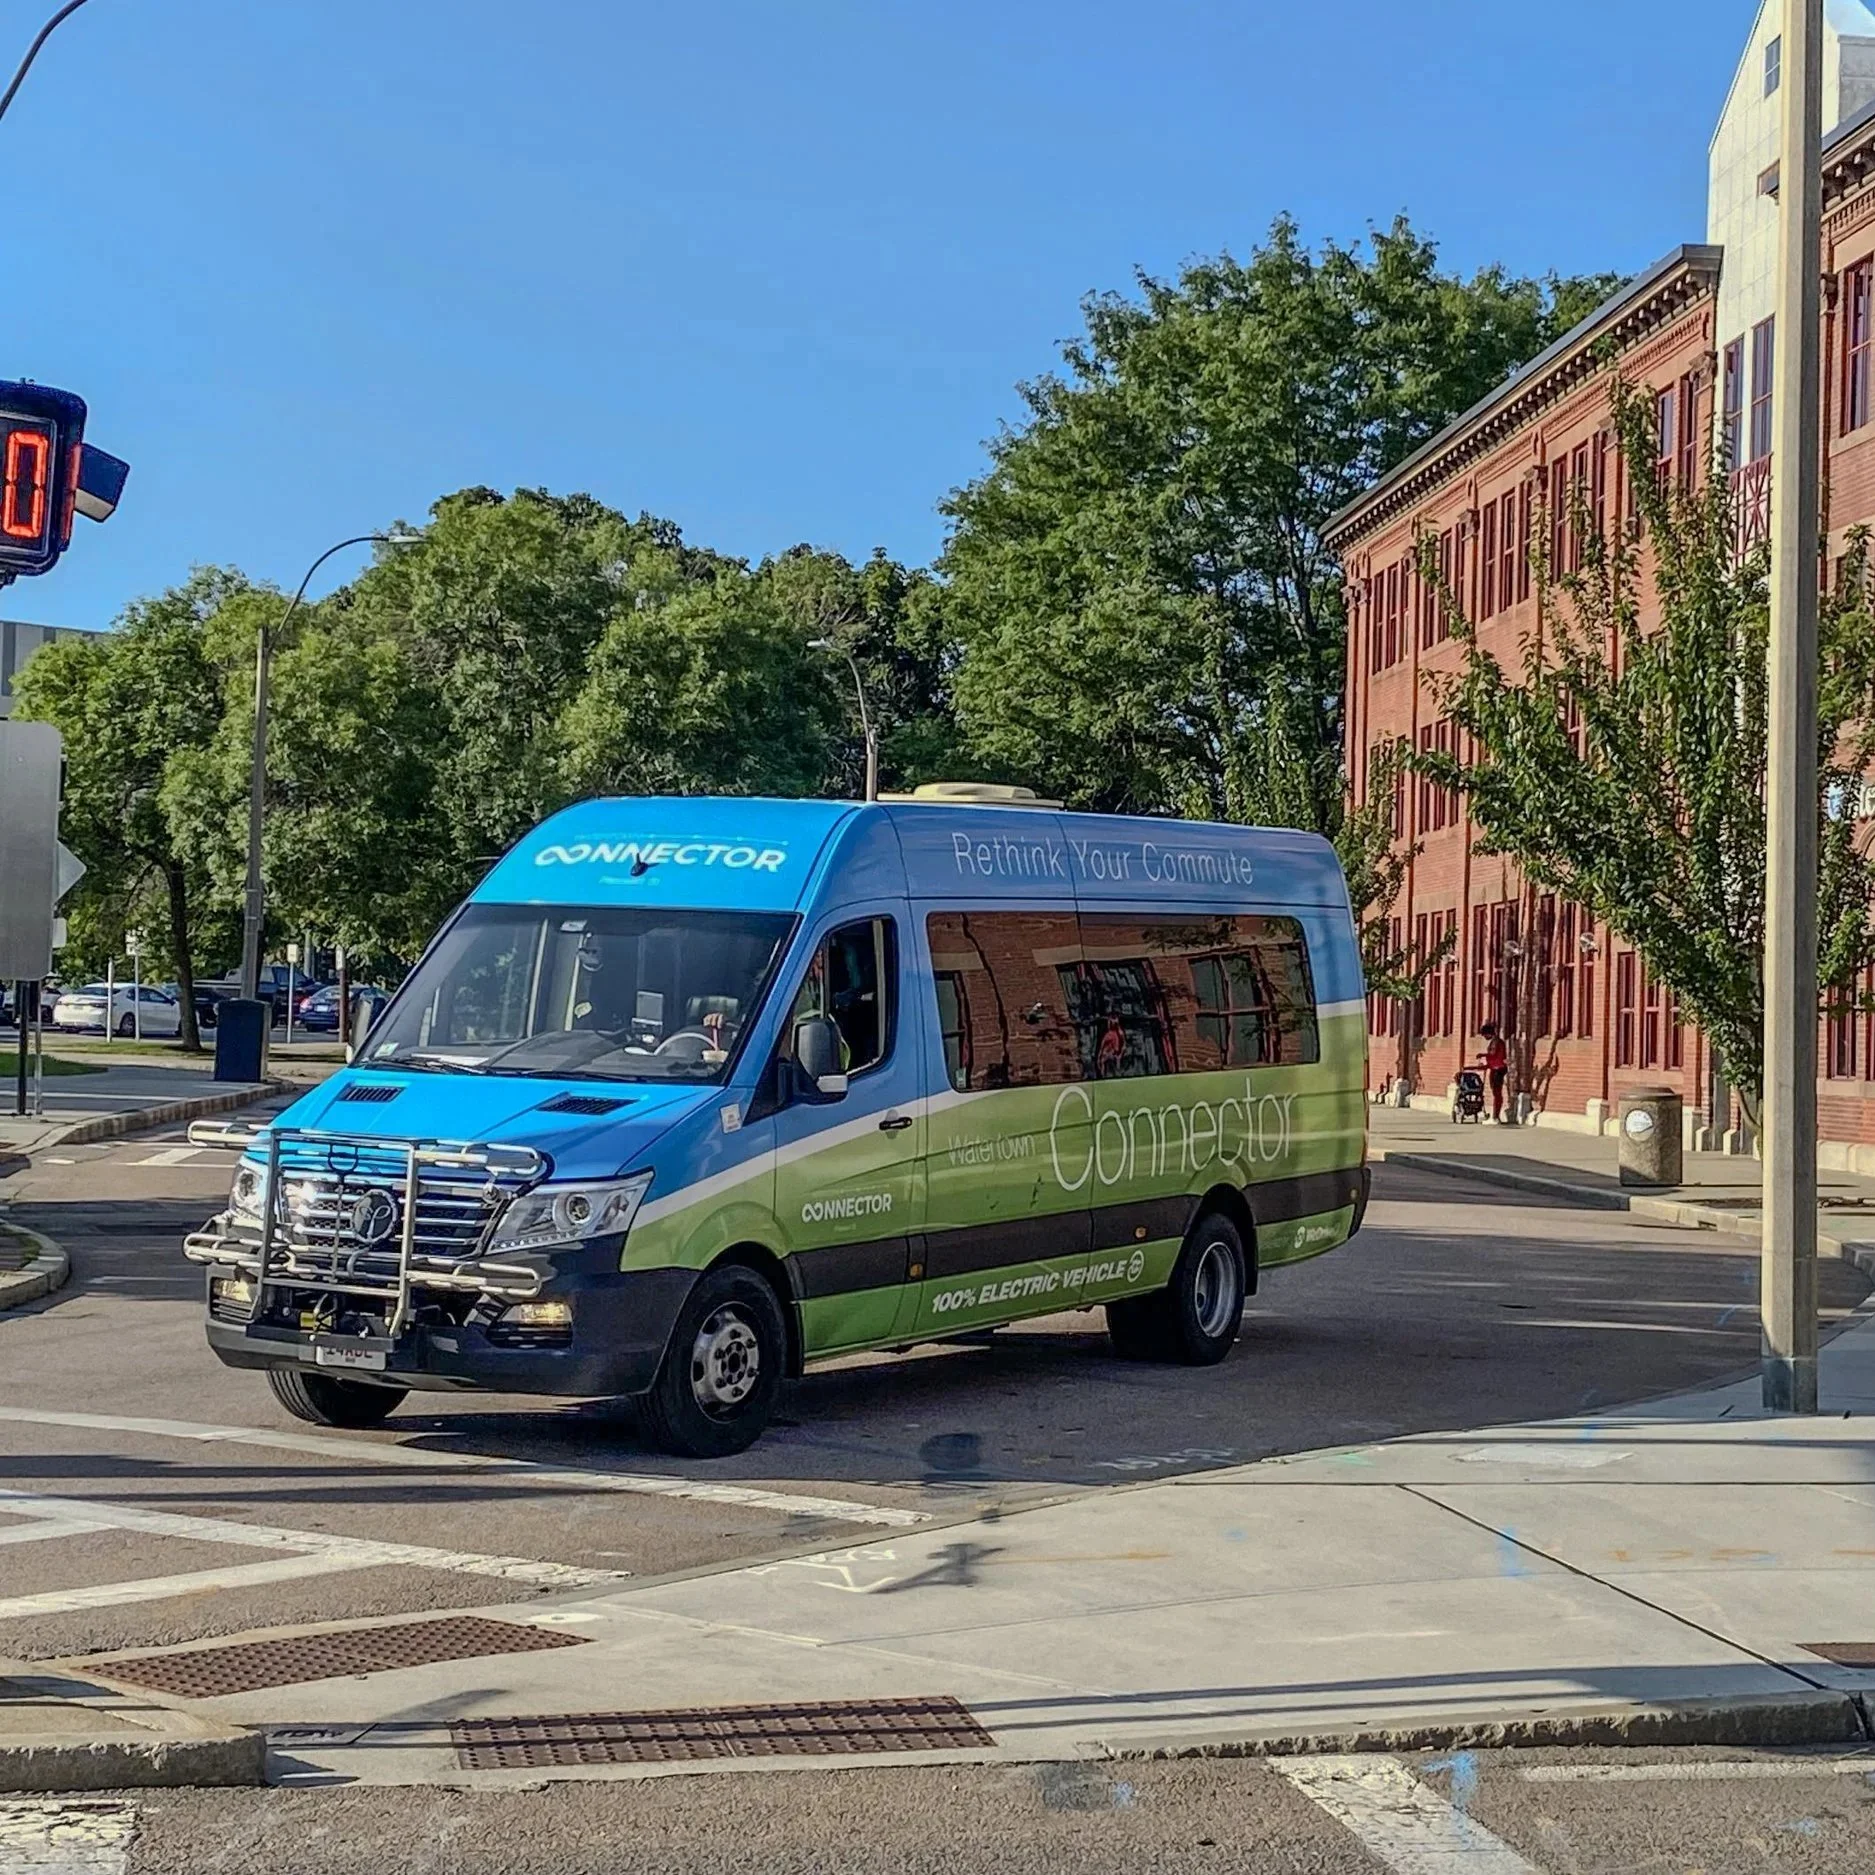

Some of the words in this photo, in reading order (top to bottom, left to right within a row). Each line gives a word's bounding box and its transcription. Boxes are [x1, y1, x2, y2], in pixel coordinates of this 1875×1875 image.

[3, 431, 48, 538] 0
[535, 842, 788, 873] CONNECTOR
[952, 832, 1066, 877] Rethink
[1070, 838, 1131, 881] Your
[1142, 841, 1254, 885] Commute
[947, 1132, 1037, 1166] Watertown
[1050, 1077, 1298, 1192] Connector
[801, 1193, 893, 1223] CONNECTOR
[931, 1287, 977, 1314] 100%
[978, 1271, 1061, 1305] ELECTRIC
[1062, 1259, 1130, 1289] VEHICLE
